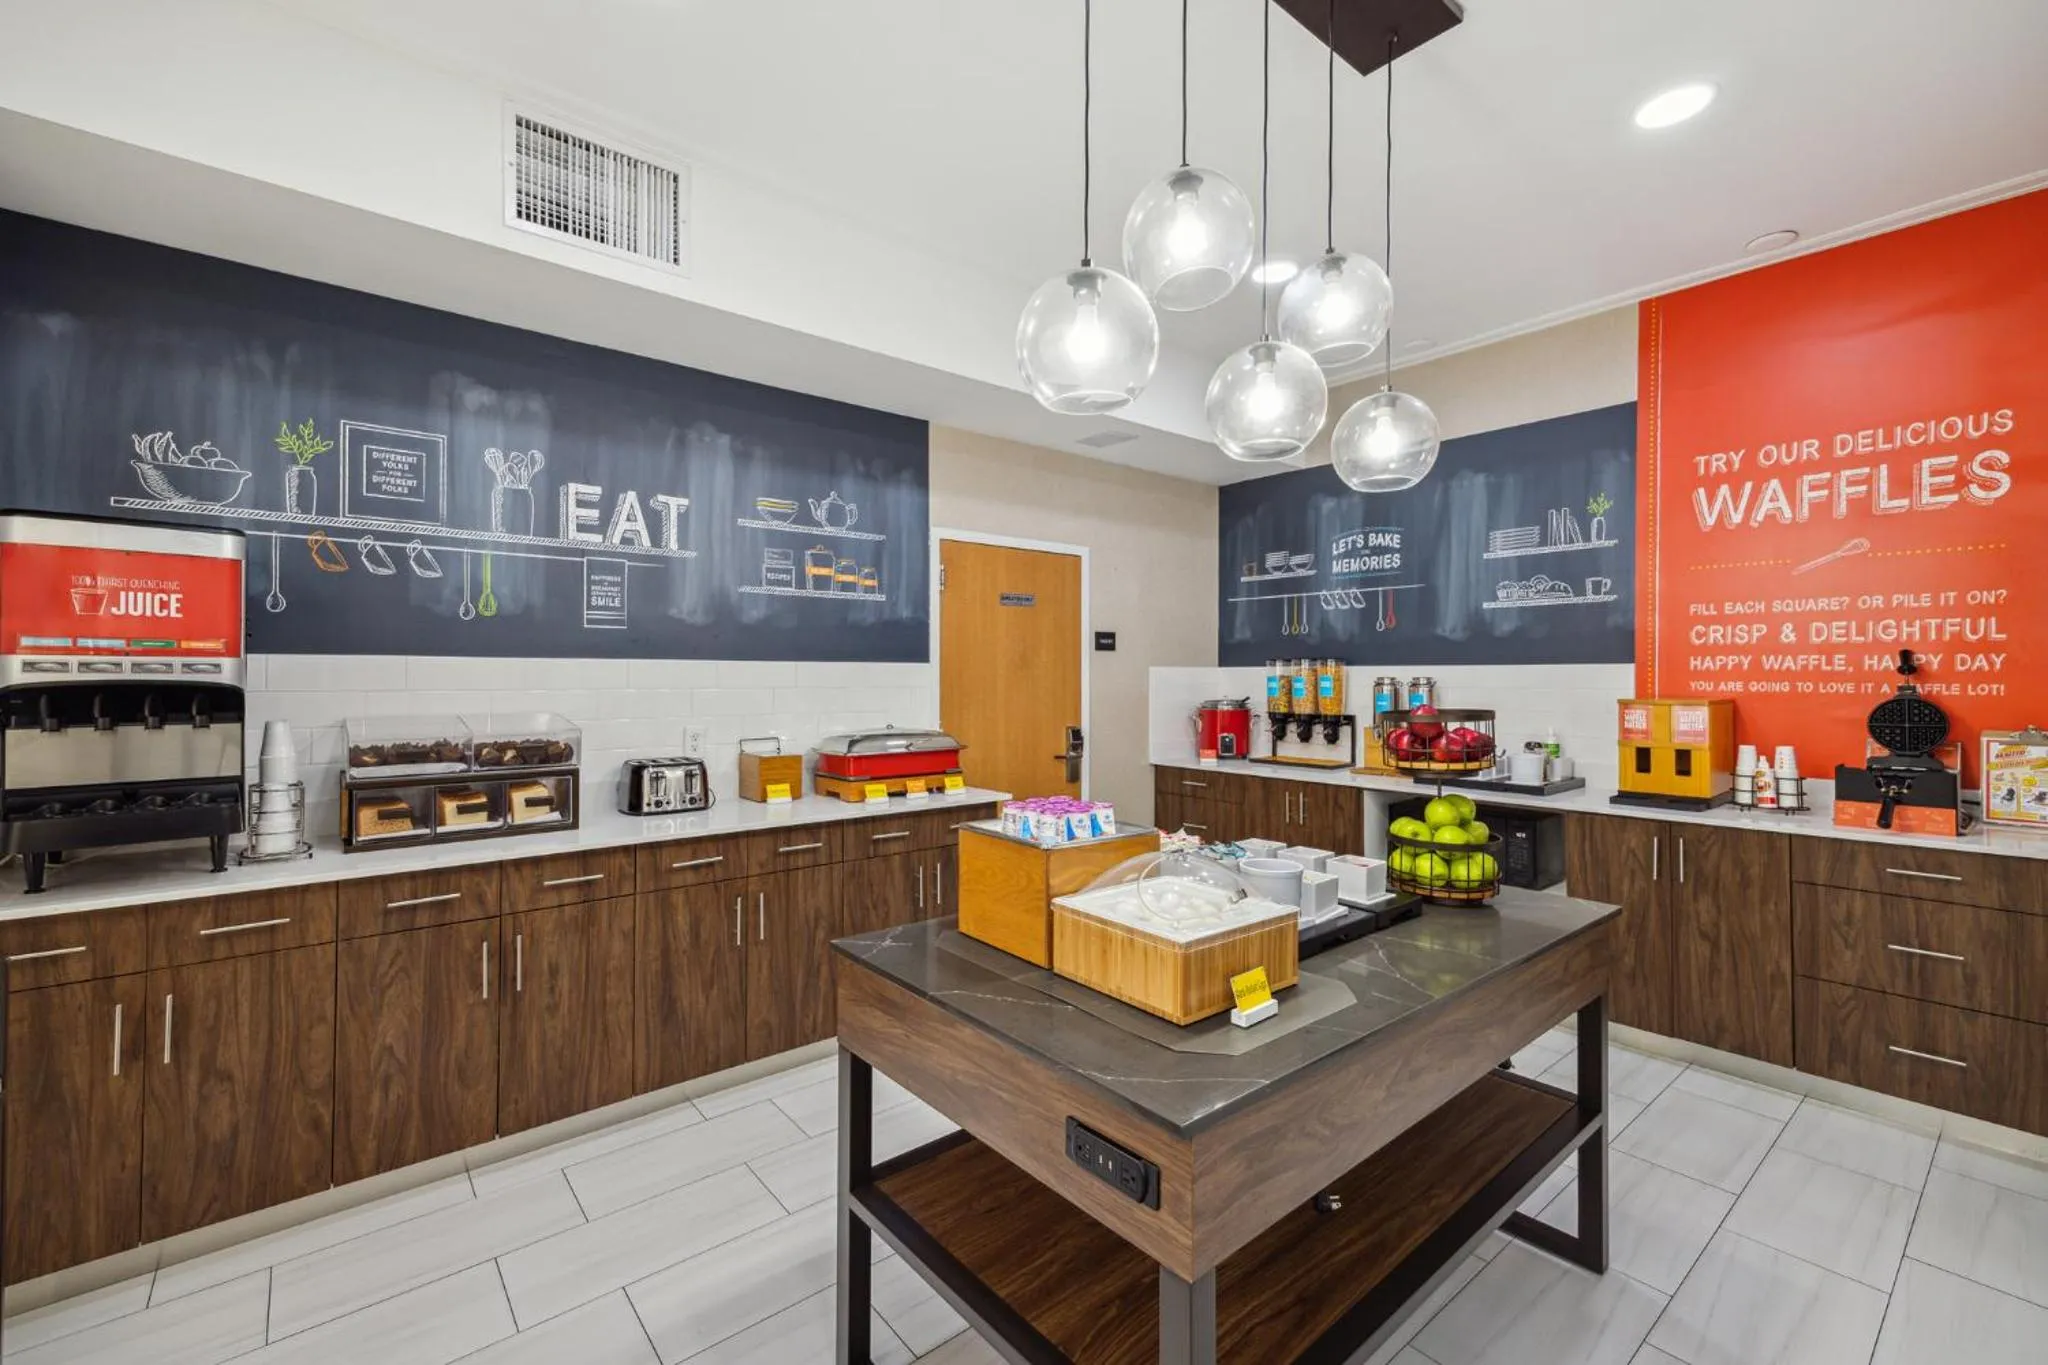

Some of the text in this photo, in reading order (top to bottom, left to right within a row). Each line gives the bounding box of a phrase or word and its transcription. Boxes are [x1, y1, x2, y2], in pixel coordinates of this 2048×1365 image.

[1693, 409, 2014, 477] TRY OUR DELICIOUS
[1692, 449, 2012, 532] WAFFLES
[559, 482, 689, 551] EAT
[1332, 532, 1401, 556] LET'S BAKE
[1332, 553, 1401, 574] MEMORIES
[110, 591, 183, 618] JUICE
[591, 596, 621, 607] SMILE
[1689, 589, 2007, 616] FILL EACH SQUARE? OR PILE IT ON?
[1690, 616, 2007, 646] CRISP & DELIGHTFUL
[1689, 653, 2007, 673] HAPPY WAFFLE. HAPY DAY
[1689, 681, 2005, 696] YOU ARE GOING TO LOVE IT A AFFLE LOT!
